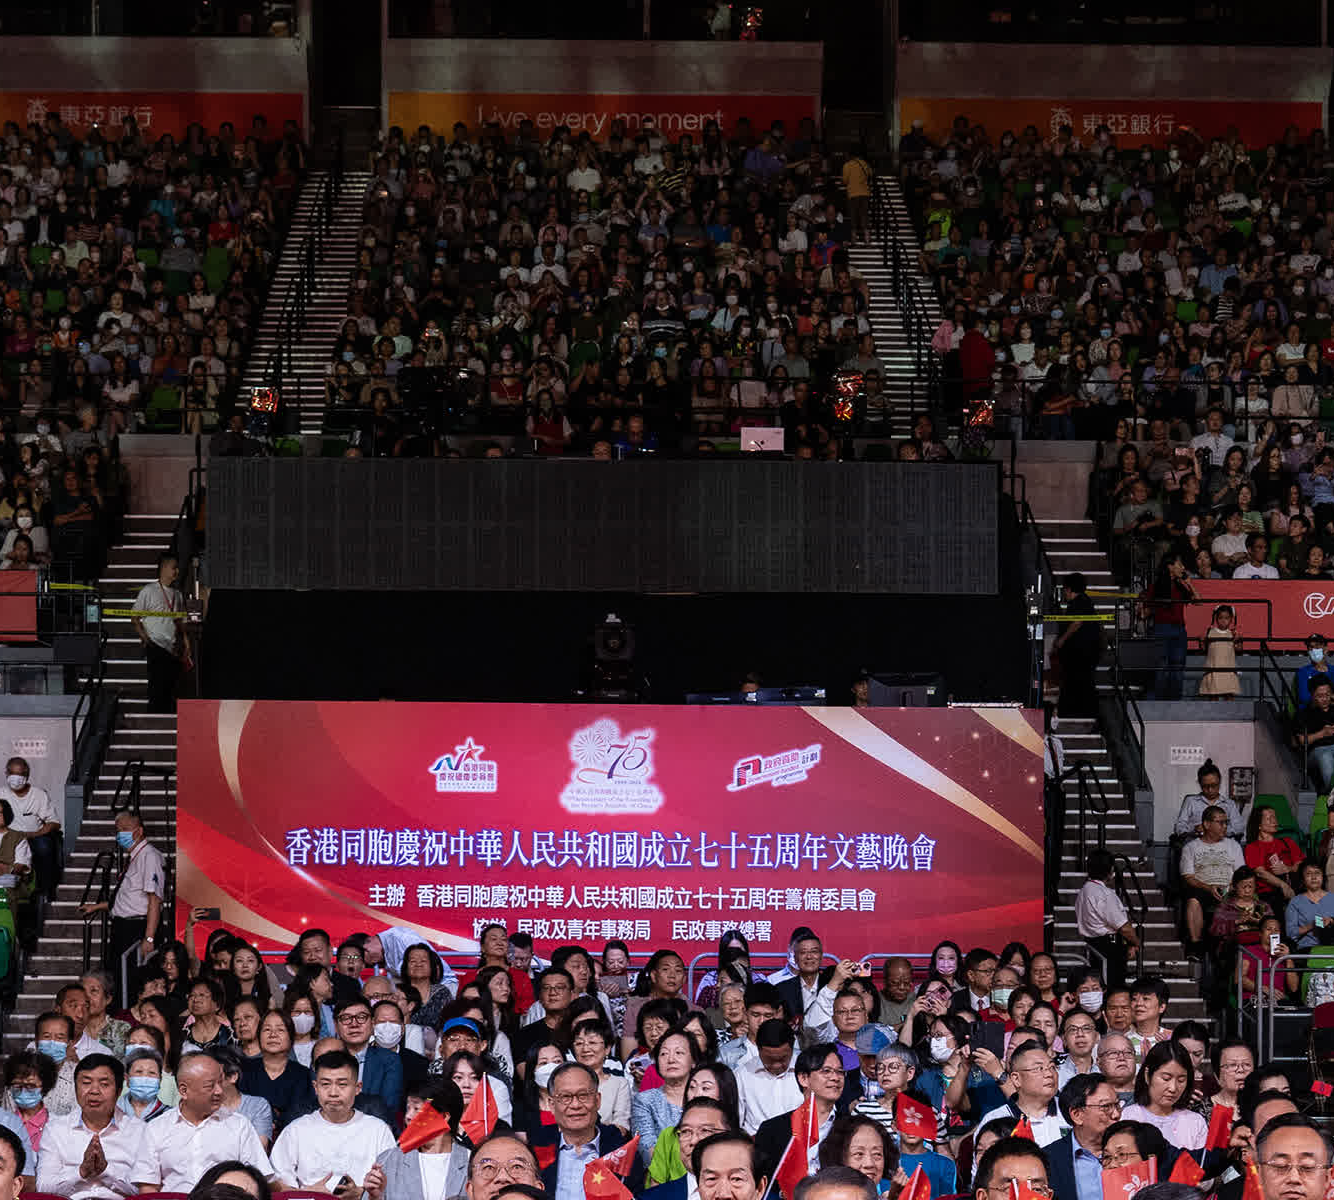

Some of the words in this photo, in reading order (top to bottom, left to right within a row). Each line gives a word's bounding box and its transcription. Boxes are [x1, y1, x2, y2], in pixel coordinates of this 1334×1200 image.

[476, 104, 528, 128] Live
[536, 110, 606, 135] every
[1082, 113, 1174, 136] 東亞銀行
[607, 732, 651, 779] 75
[285, 828, 936, 871] 香港同胞慶祝中華人民共和國成立七十五周年文藝晚會
[368, 884, 406, 907] 主辦
[417, 884, 876, 911] 香港同胞慶祝中華人民共和國成立七十五周年籌備委員會
[517, 918, 651, 941] 民政及青年事務局
